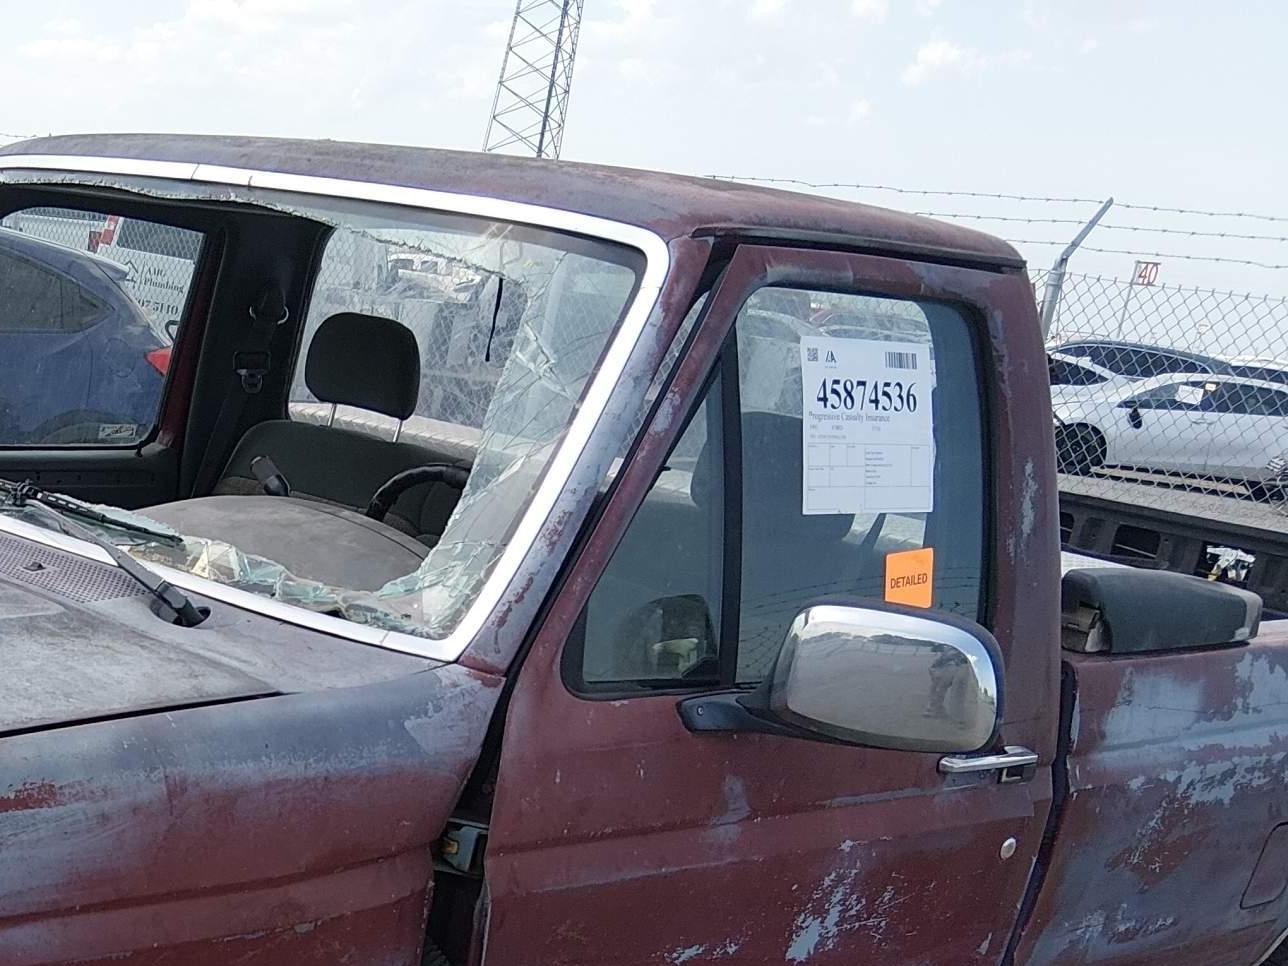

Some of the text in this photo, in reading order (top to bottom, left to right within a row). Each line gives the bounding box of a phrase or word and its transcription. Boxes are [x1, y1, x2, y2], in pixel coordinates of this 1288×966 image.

[1138, 264, 1159, 284] 40
[144, 278, 185, 296] Plumbing
[816, 378, 918, 413] 45874536
[890, 573, 928, 590] DETAILED
